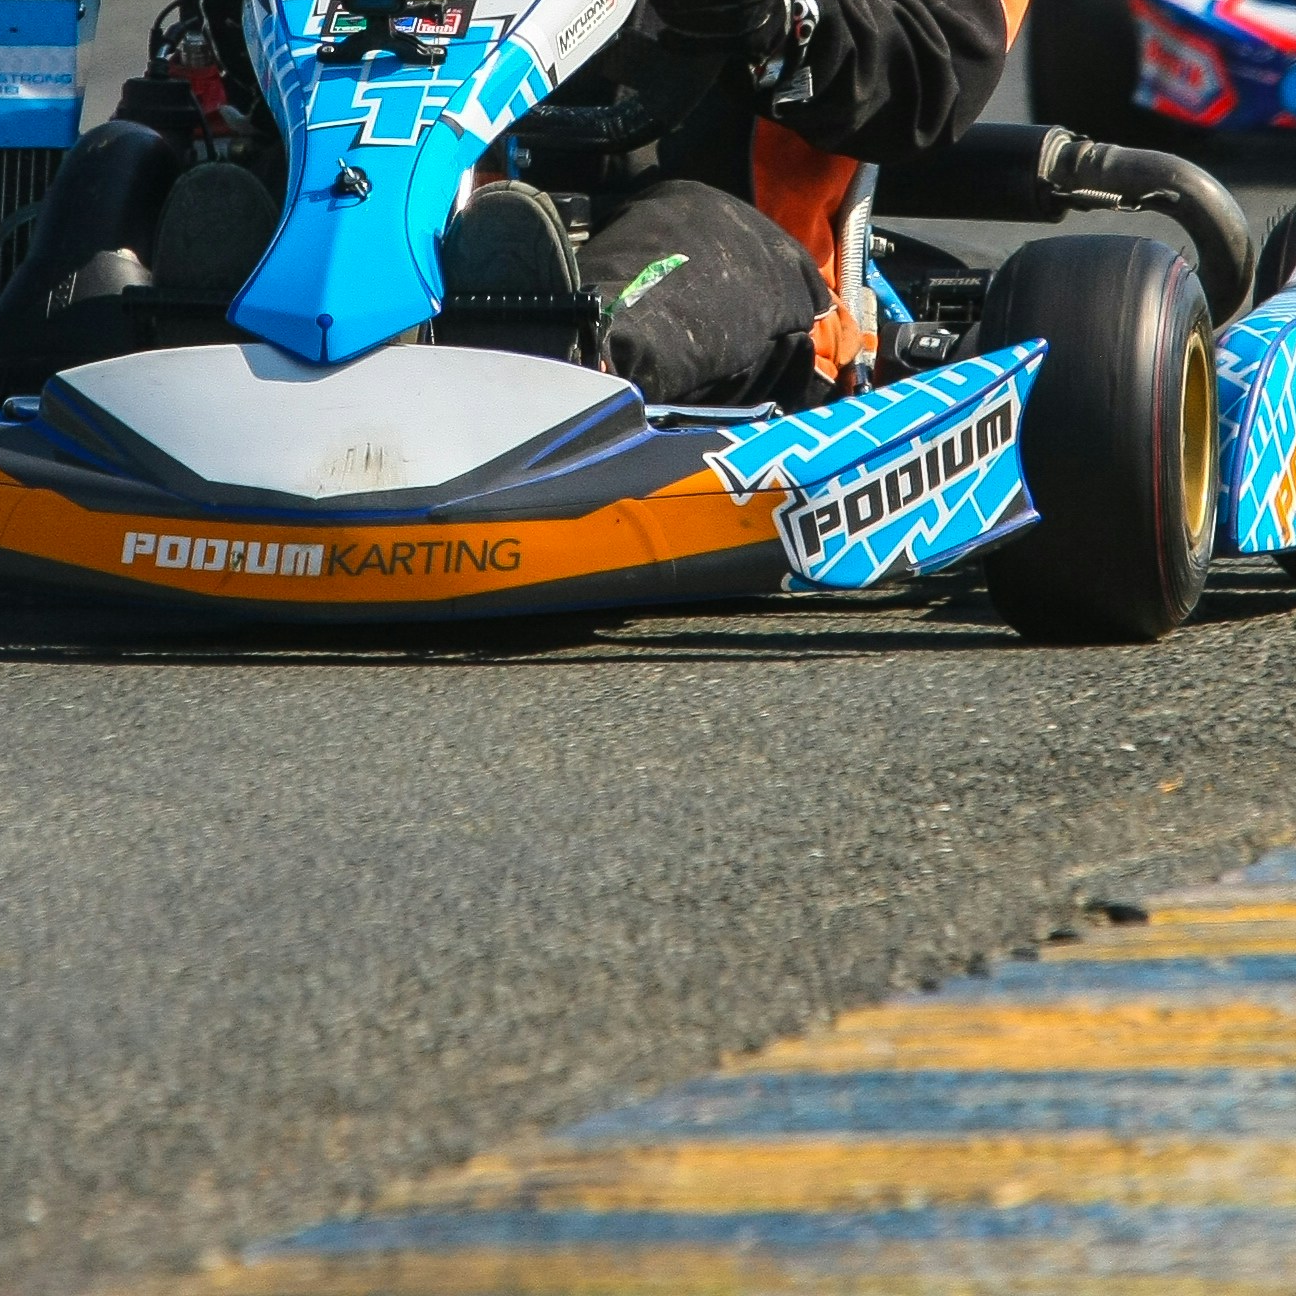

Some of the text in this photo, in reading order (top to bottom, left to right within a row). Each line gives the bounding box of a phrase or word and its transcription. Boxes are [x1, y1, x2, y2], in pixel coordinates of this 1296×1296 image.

[801, 398, 1015, 557] PODIUM
[121, 532, 522, 578] PODIUM KARTING
